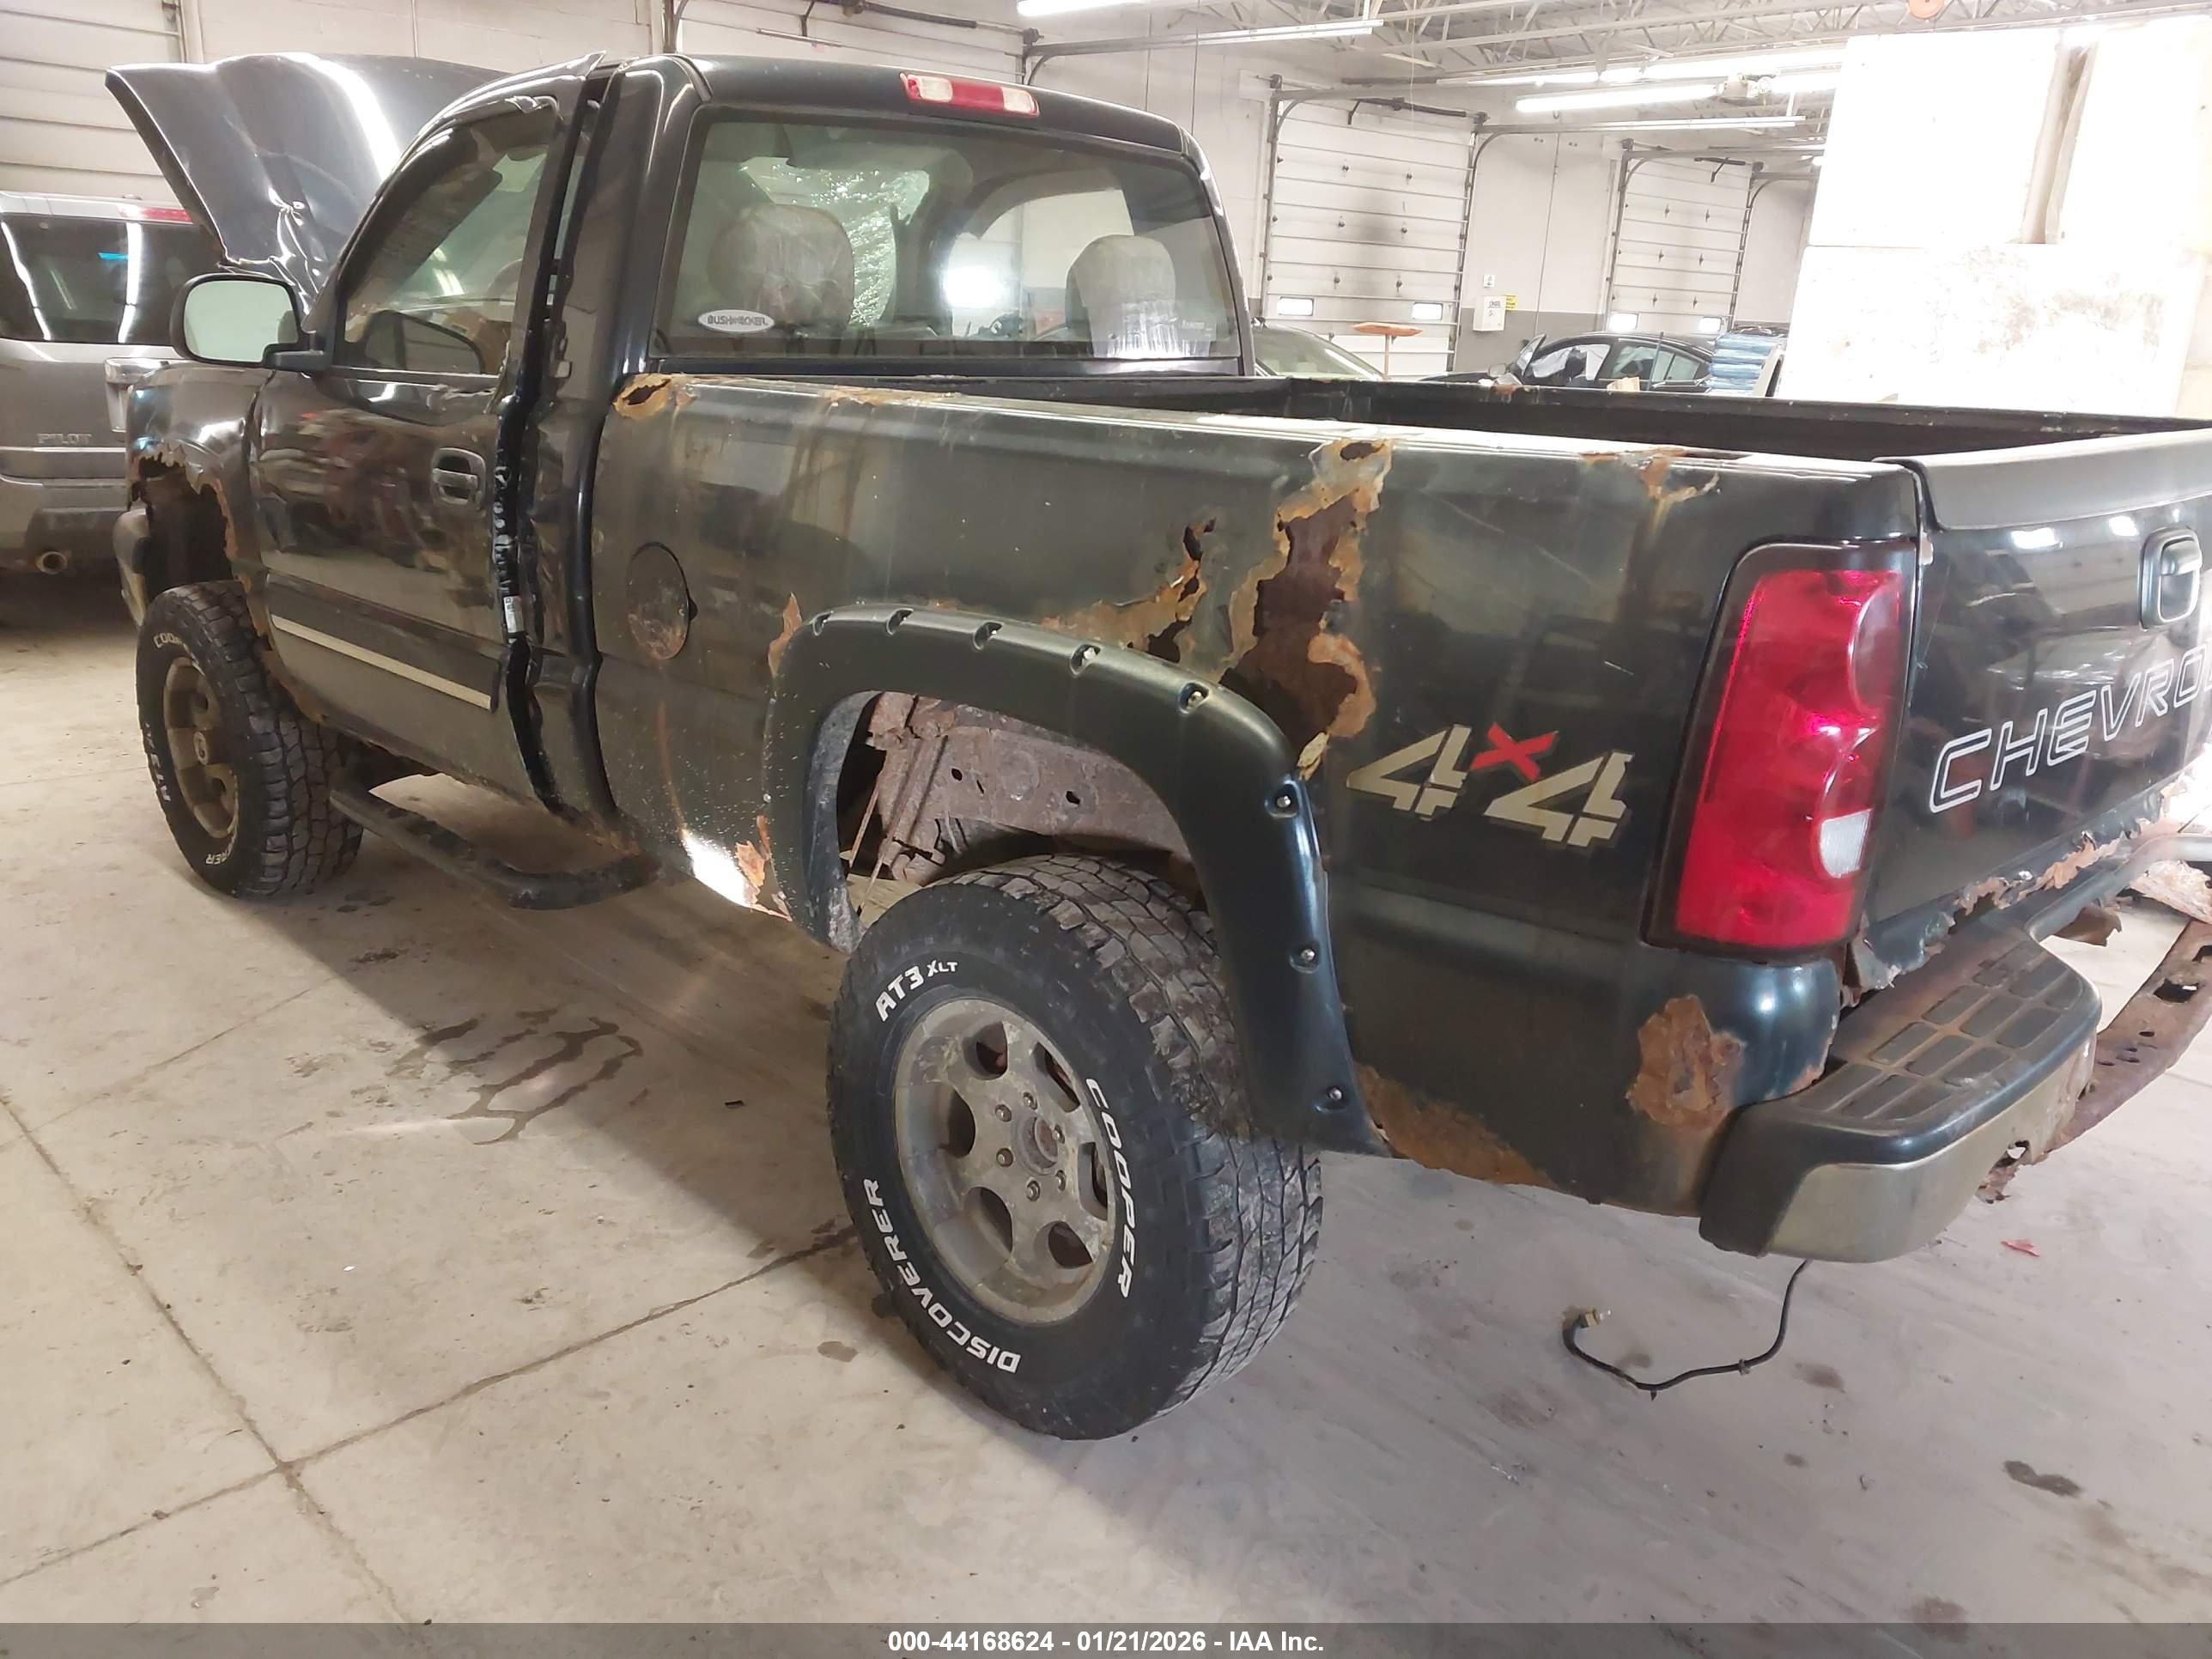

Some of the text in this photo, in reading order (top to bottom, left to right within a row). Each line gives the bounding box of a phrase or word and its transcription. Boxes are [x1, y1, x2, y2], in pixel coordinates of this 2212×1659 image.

[875, 959, 958, 1023] AT3 XLT
[862, 1177, 1022, 1374] DISCOVERER
[1085, 1078, 1136, 1298] COOPER
